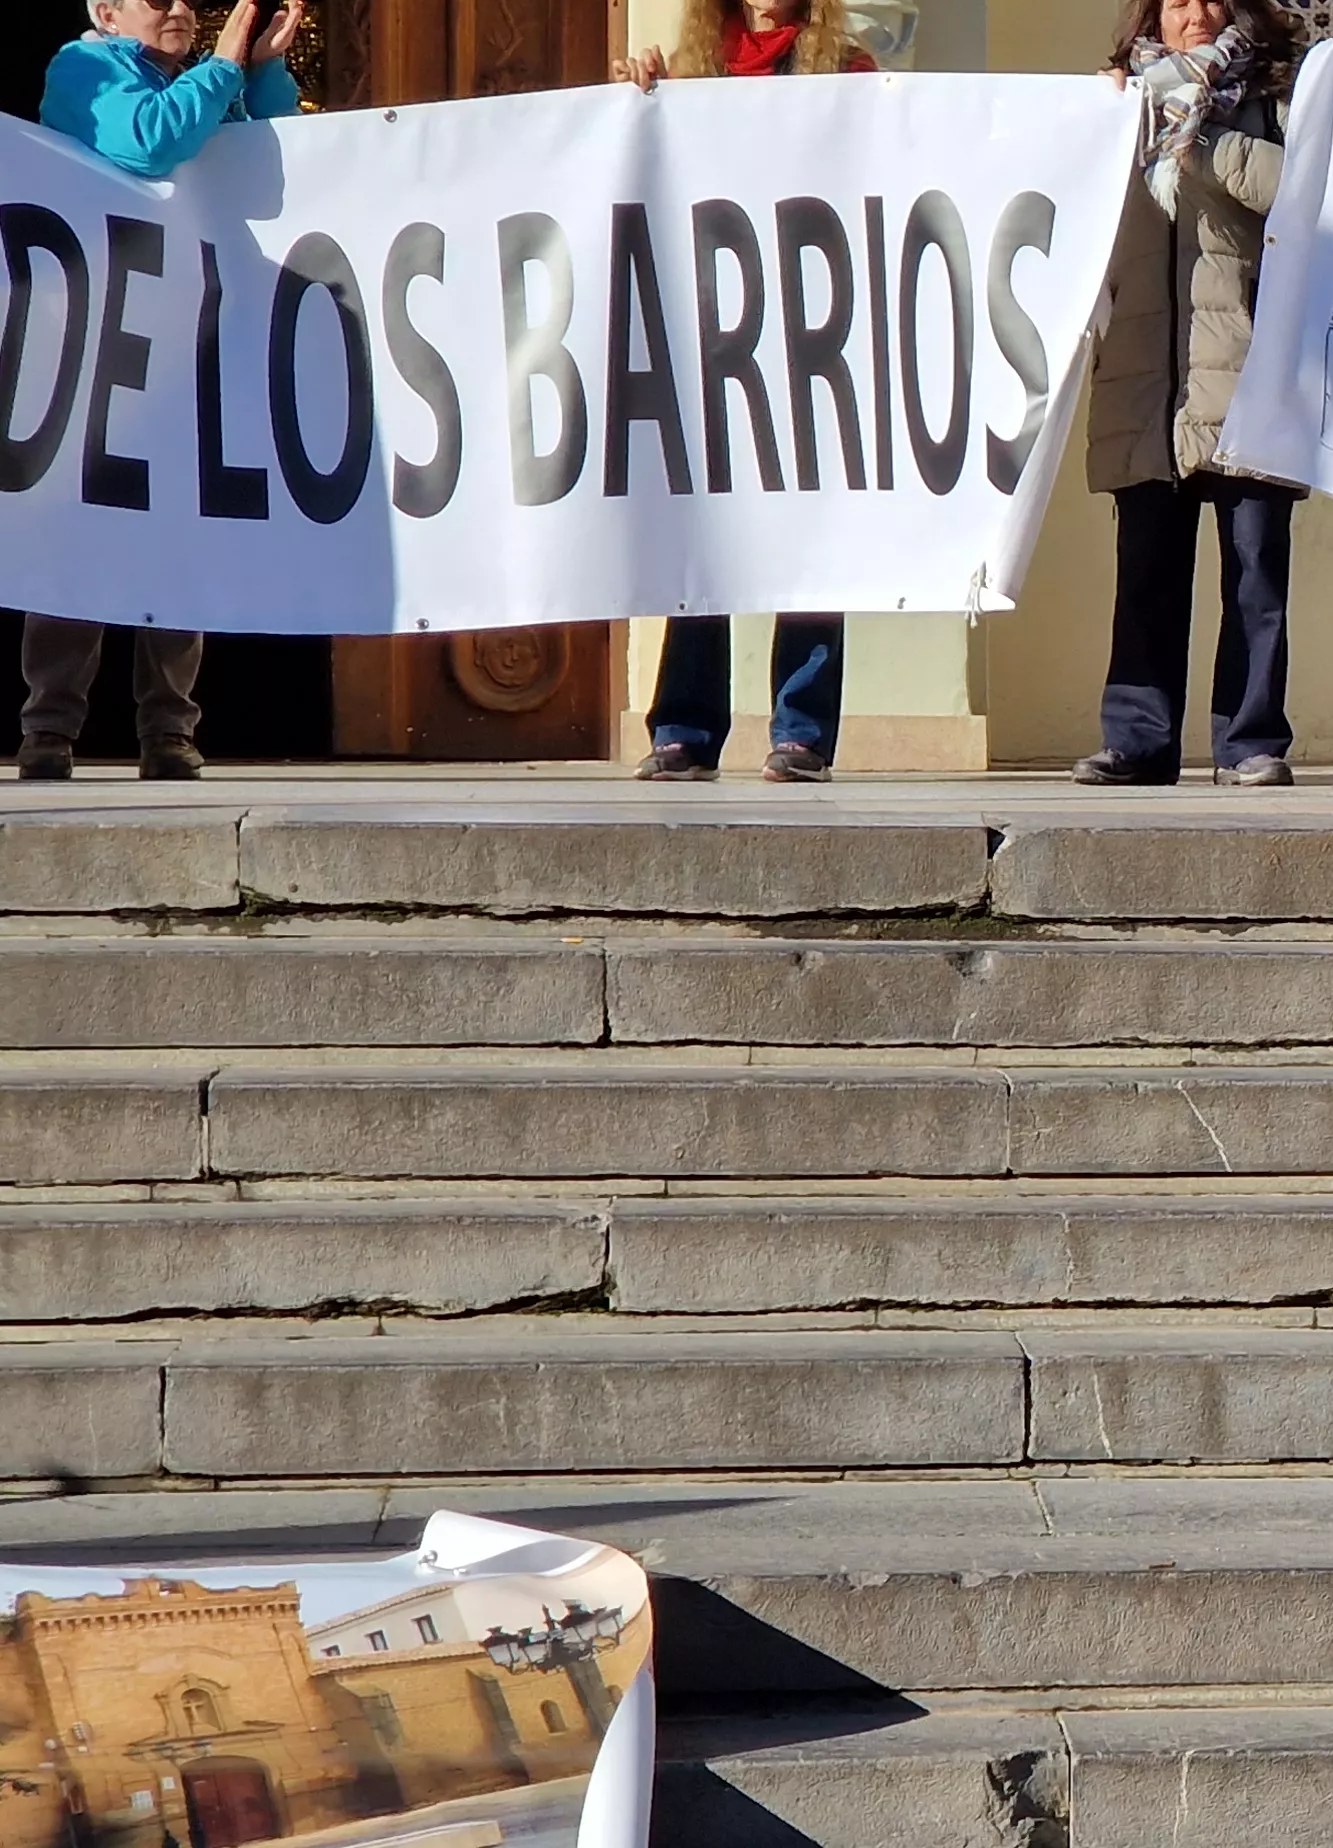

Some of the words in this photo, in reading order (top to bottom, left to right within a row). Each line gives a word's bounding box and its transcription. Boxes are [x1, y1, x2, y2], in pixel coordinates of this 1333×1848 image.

[0, 202, 165, 511] DE
[197, 221, 463, 524] LOS
[497, 190, 1056, 506] BARRIOS
